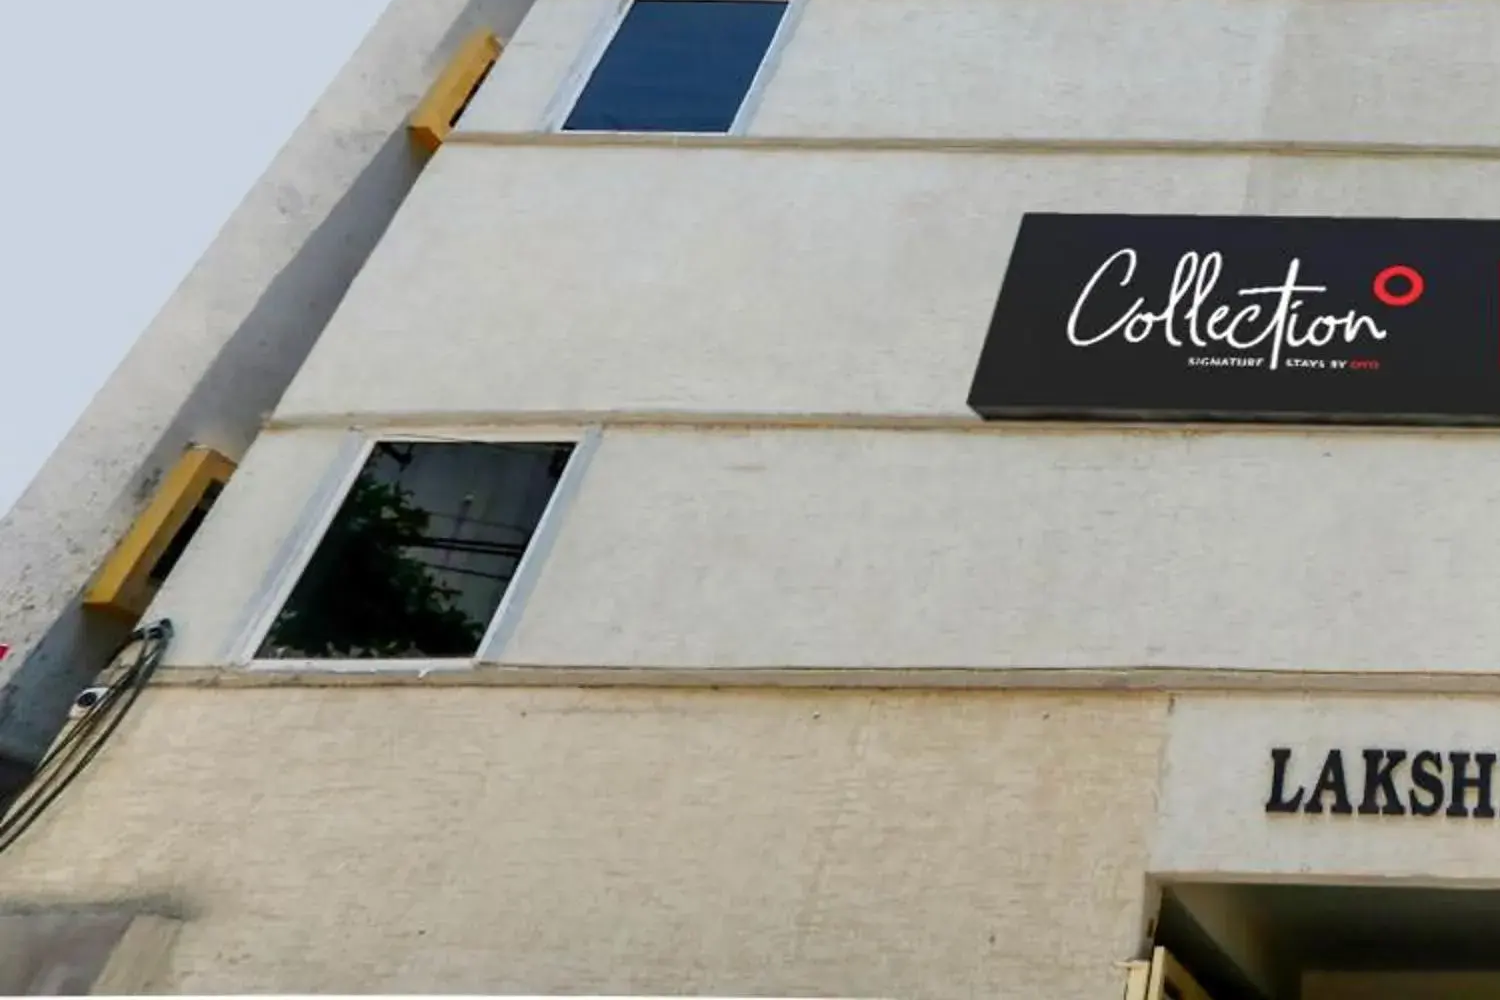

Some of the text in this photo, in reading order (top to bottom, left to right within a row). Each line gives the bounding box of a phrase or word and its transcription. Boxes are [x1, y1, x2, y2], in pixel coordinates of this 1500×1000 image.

[1067, 248, 1387, 370] Collection
[1188, 356, 1264, 368] SIGNATURE
[1285, 358, 1325, 369] STAYS
[1330, 360, 1348, 369] BY
